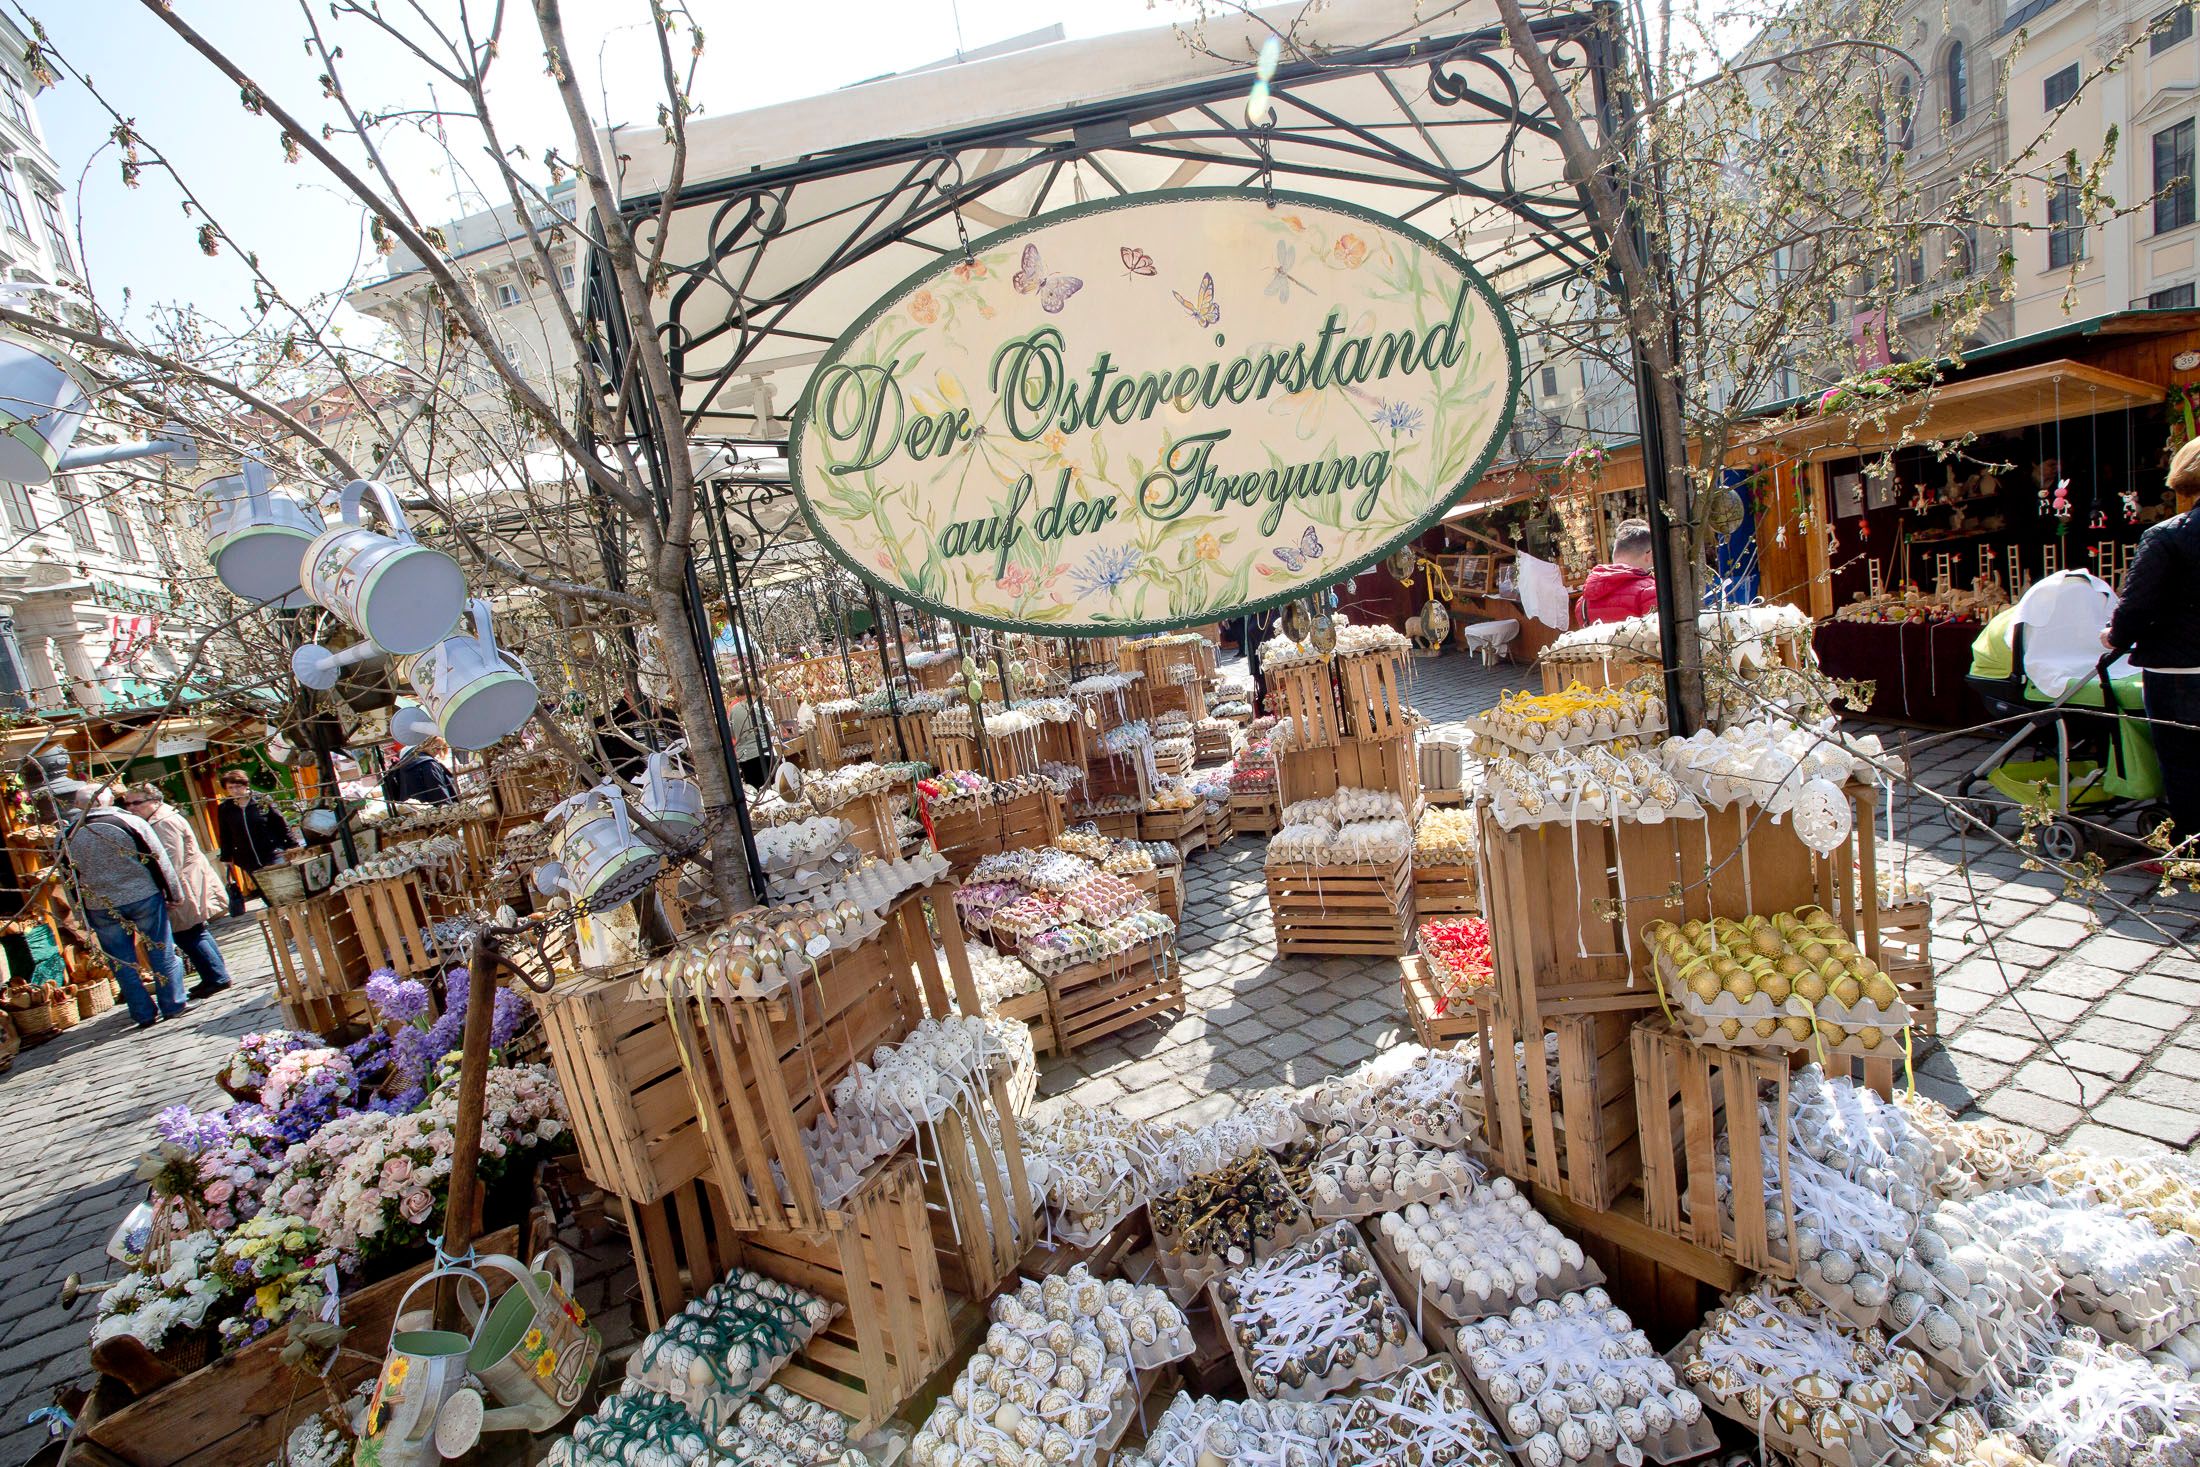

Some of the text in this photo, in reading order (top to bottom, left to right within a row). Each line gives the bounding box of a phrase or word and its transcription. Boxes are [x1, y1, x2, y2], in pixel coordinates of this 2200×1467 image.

[811, 279, 1471, 476] Der Ostereierstand
[939, 429, 1391, 580] auf der Freyung
